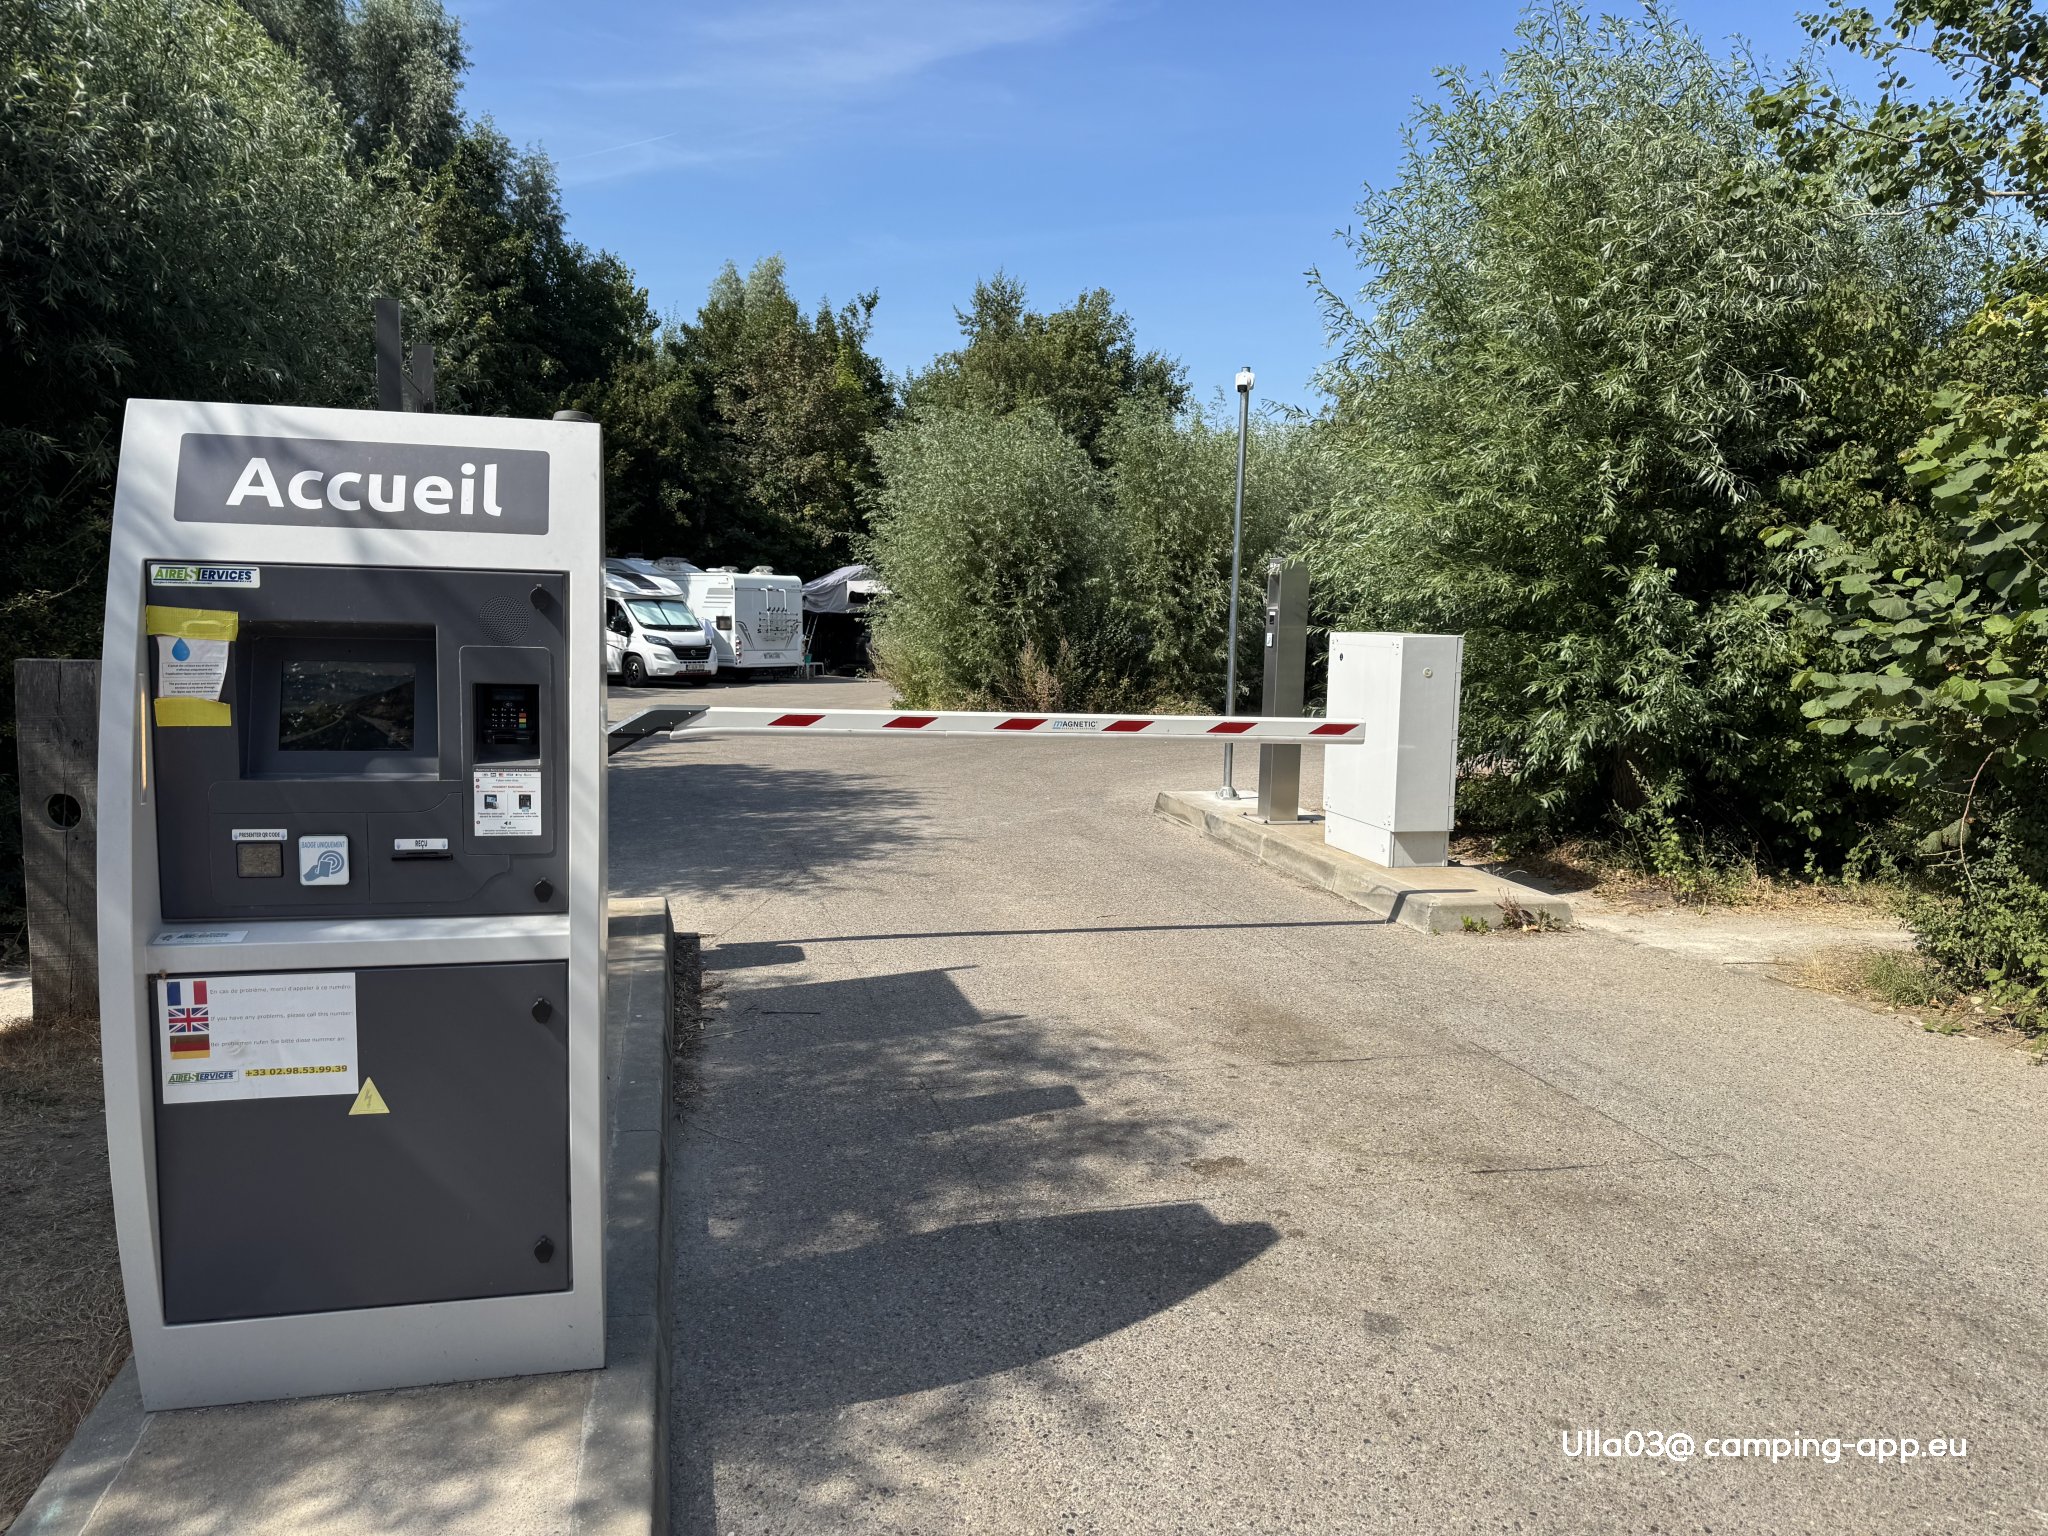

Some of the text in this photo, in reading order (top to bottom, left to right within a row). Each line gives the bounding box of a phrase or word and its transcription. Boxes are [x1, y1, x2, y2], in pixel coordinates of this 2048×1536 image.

[225, 457, 502, 517] Accueil
[301, 840, 345, 849] BADGE UNIQUEMENT
[245, 1065, 348, 1077] +33 02.98.53.99.39
